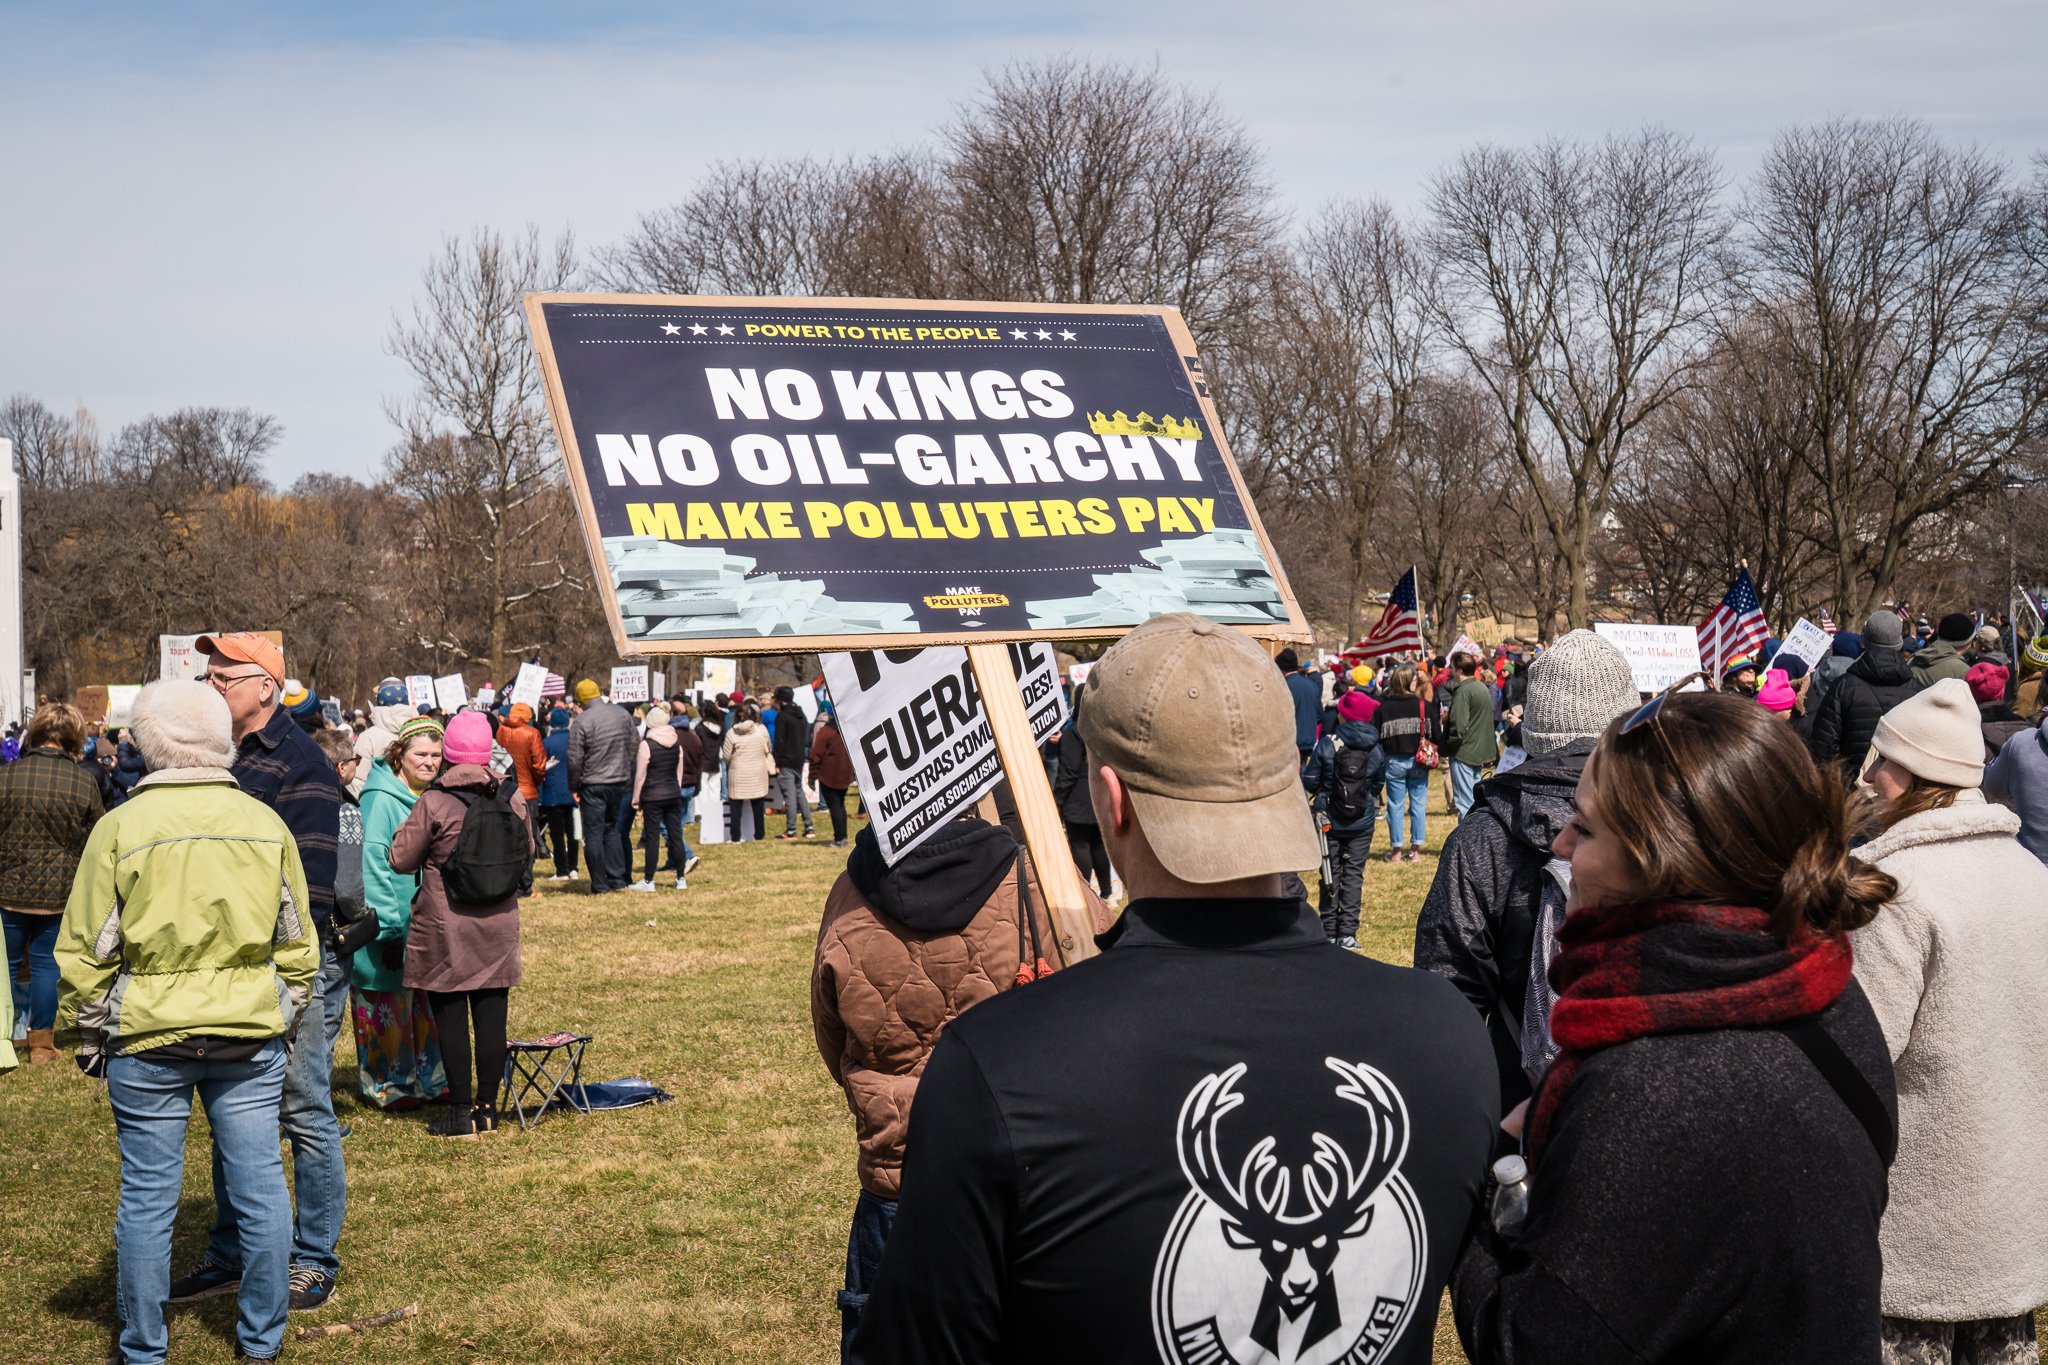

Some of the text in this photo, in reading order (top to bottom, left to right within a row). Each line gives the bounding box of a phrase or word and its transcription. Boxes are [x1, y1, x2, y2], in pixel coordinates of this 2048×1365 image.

[745, 324, 1001, 341] POWER TO THE PEOPLE
[705, 368, 1075, 421] NO KINGS
[595, 431, 1203, 487] NO OIL-GARCHY
[625, 497, 1216, 540] MAKE POLLUTERS PAY
[945, 586, 982, 596] MAKE
[931, 597, 1003, 606] POLLUTERS
[959, 607, 982, 616] PAY
[1613, 631, 1677, 644] INVESTING 101
[616, 676, 643, 685] HOPE
[615, 690, 646, 700] TIMES
[860, 658, 982, 791] FUERA
[879, 750, 955, 822] NUESTRAS
[893, 811, 925, 847] PARTY
[925, 796, 947, 821] FOR
[945, 755, 998, 805] SOCIALISM
